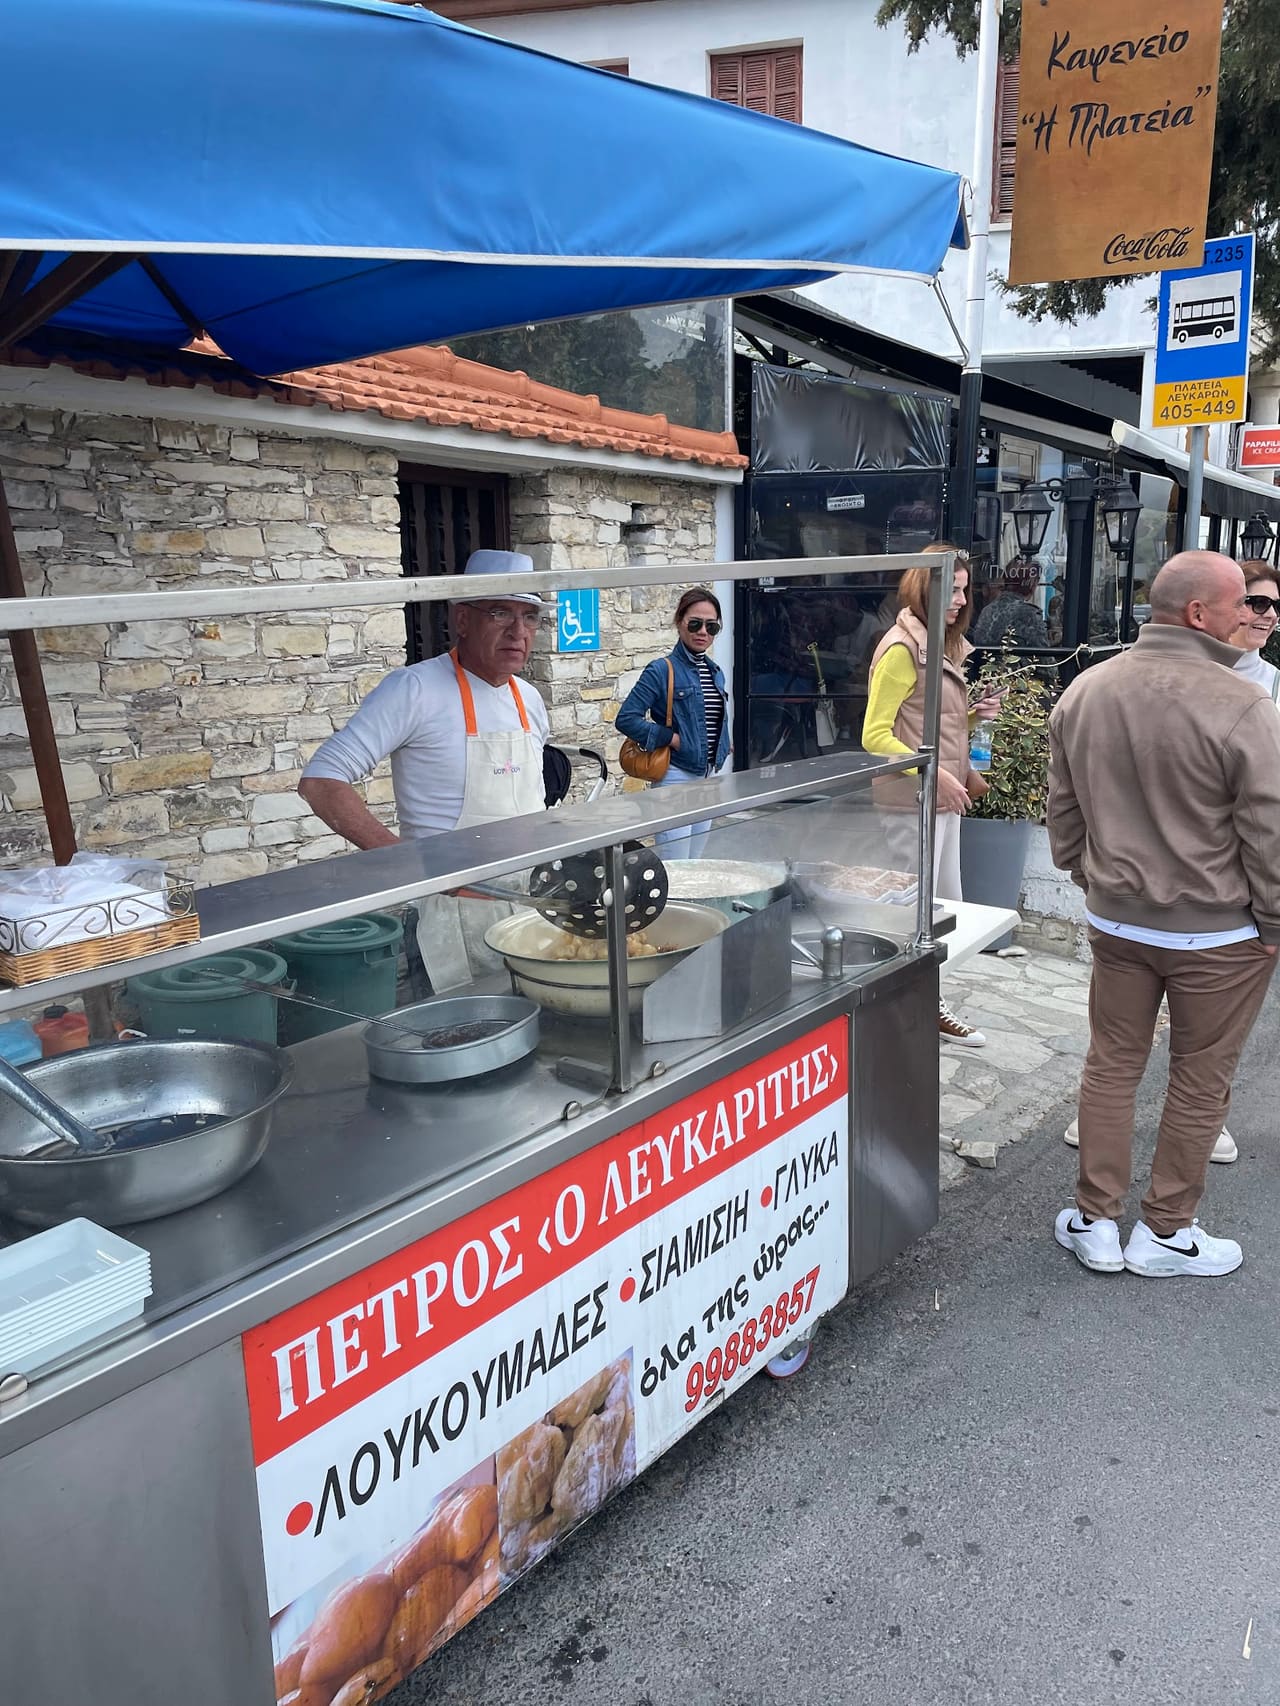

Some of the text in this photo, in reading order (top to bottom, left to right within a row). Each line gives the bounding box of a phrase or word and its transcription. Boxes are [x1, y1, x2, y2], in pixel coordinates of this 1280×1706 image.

[1047, 24, 1190, 83] Καφενείο
[1103, 226, 1195, 265] Coca-Cola
[1160, 400, 1236, 420] 405-449
[1168, 389, 1229, 402] ΛΕΥΚΑΡΩΝ
[1174, 381, 1222, 392] ΠΛΑΤΕΙΑ
[271, 1215, 523, 1423] ΠΕΤΡΟΣ
[640, 1325, 697, 1398] όλα
[702, 1273, 749, 1335] της
[684, 1264, 821, 1413] 99883857
